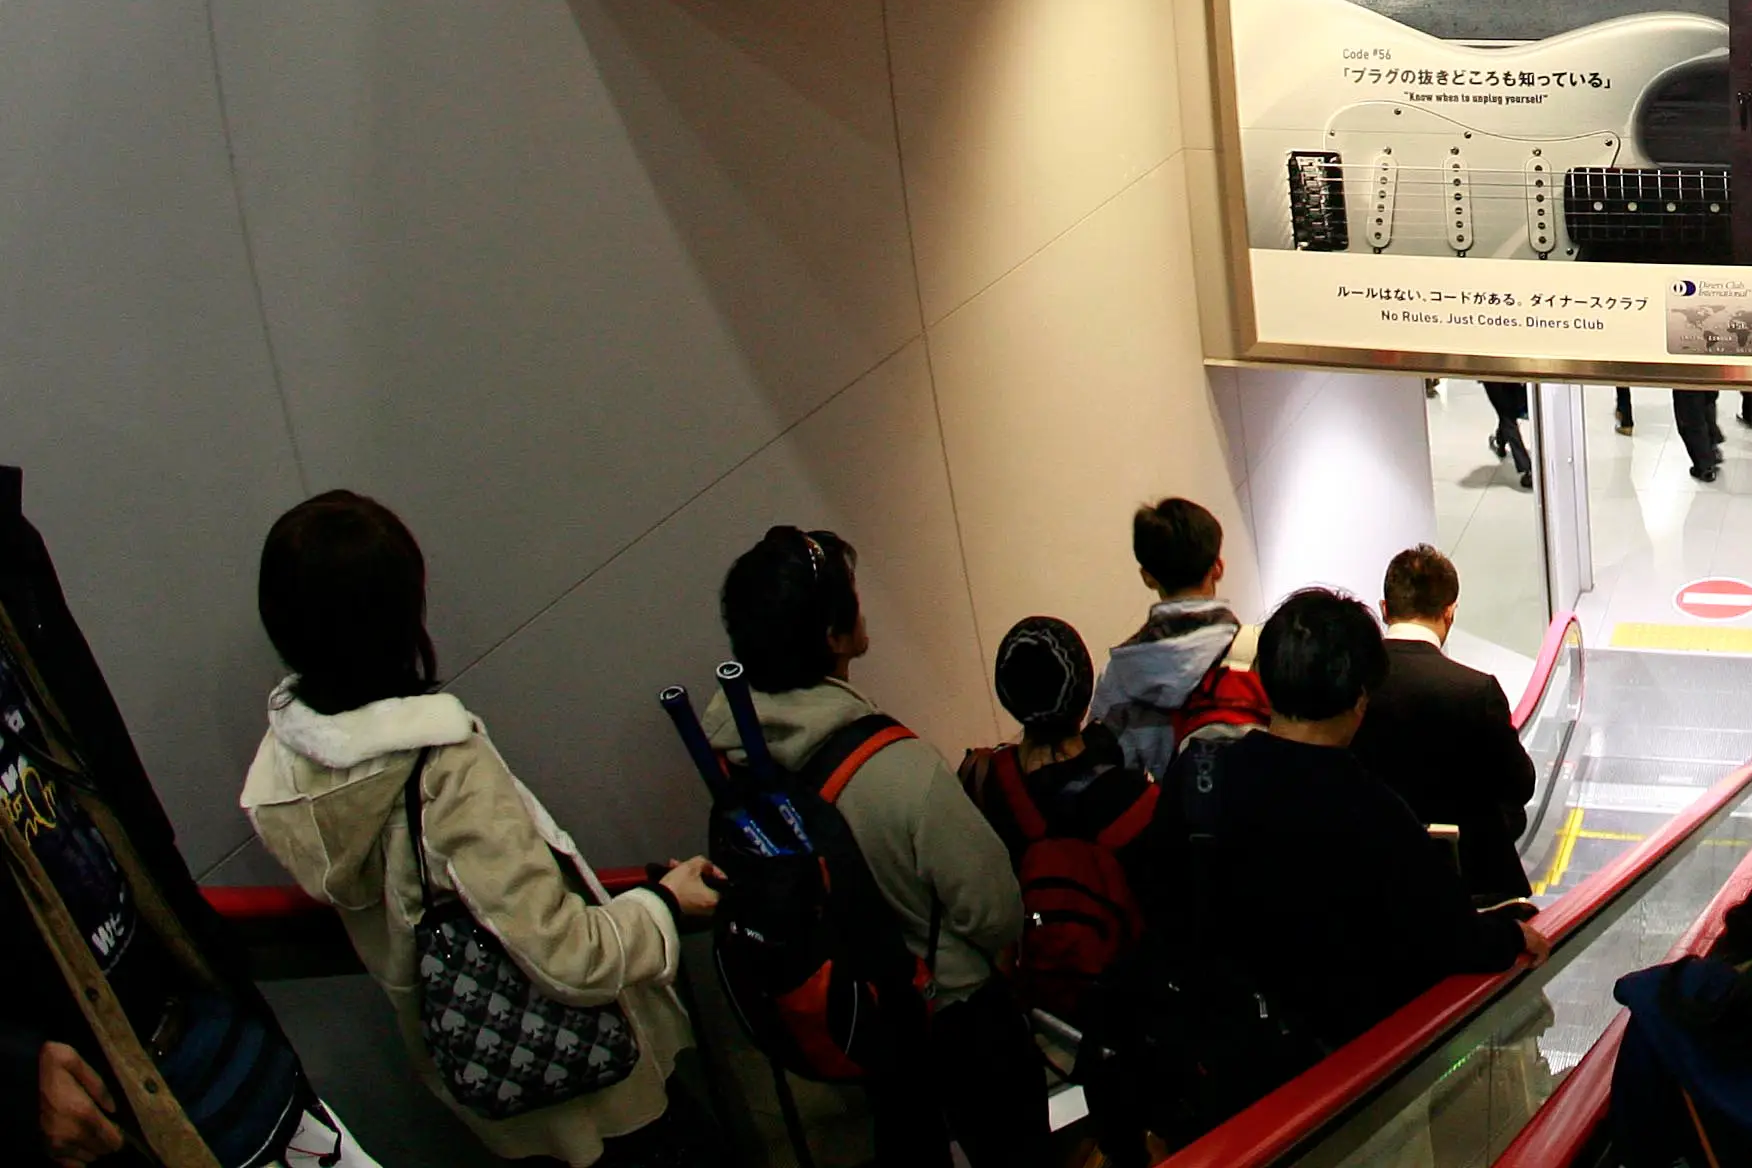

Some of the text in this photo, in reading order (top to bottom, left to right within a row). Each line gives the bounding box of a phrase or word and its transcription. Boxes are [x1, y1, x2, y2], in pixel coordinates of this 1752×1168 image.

[1342, 47, 1370, 61] Code
[1436, 93, 1459, 103] when
[1461, 93, 1470, 103] to
[1472, 93, 1503, 105] unplug
[1380, 310, 1399, 322] No
[1446, 313, 1474, 326] Just
[1477, 315, 1523, 328] Codes.
[1525, 317, 1571, 330] Diners
[1573, 318, 1605, 331] Club
